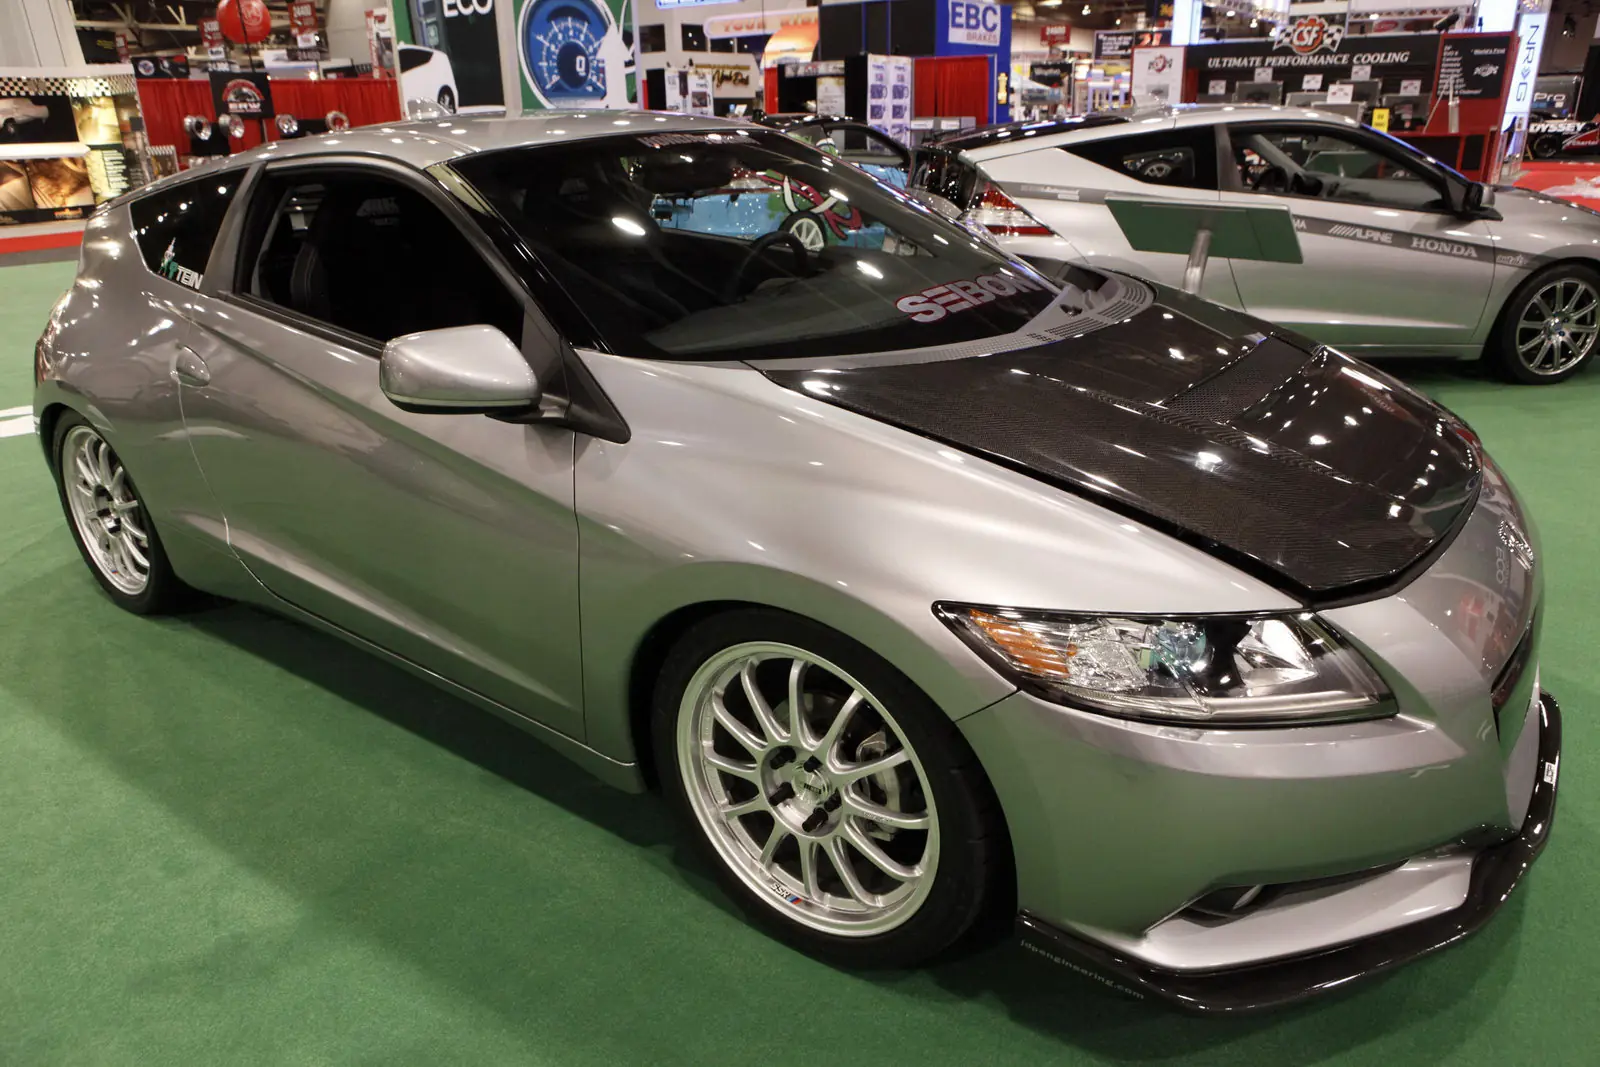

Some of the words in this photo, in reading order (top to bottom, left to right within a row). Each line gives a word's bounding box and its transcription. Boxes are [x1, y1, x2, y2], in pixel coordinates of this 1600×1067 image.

[442, 0, 493, 18] ECO
[950, 1, 998, 32] EBC
[966, 31, 998, 44] BRAKES
[1293, 25, 1319, 46] CSF
[1207, 56, 1261, 69] ULTIMATE
[1265, 54, 1350, 67] PERFORMANCE
[1353, 51, 1411, 64] COOLING
[1515, 25, 1540, 102] NRG
[1534, 92, 1566, 102] Pro
[1352, 227, 1393, 244] ALPINE
[1410, 236, 1478, 258] HONDA
[176, 264, 204, 290] TEIN
[770, 882, 791, 900] SSR
[1021, 939, 1144, 999] jdpengineering.com
